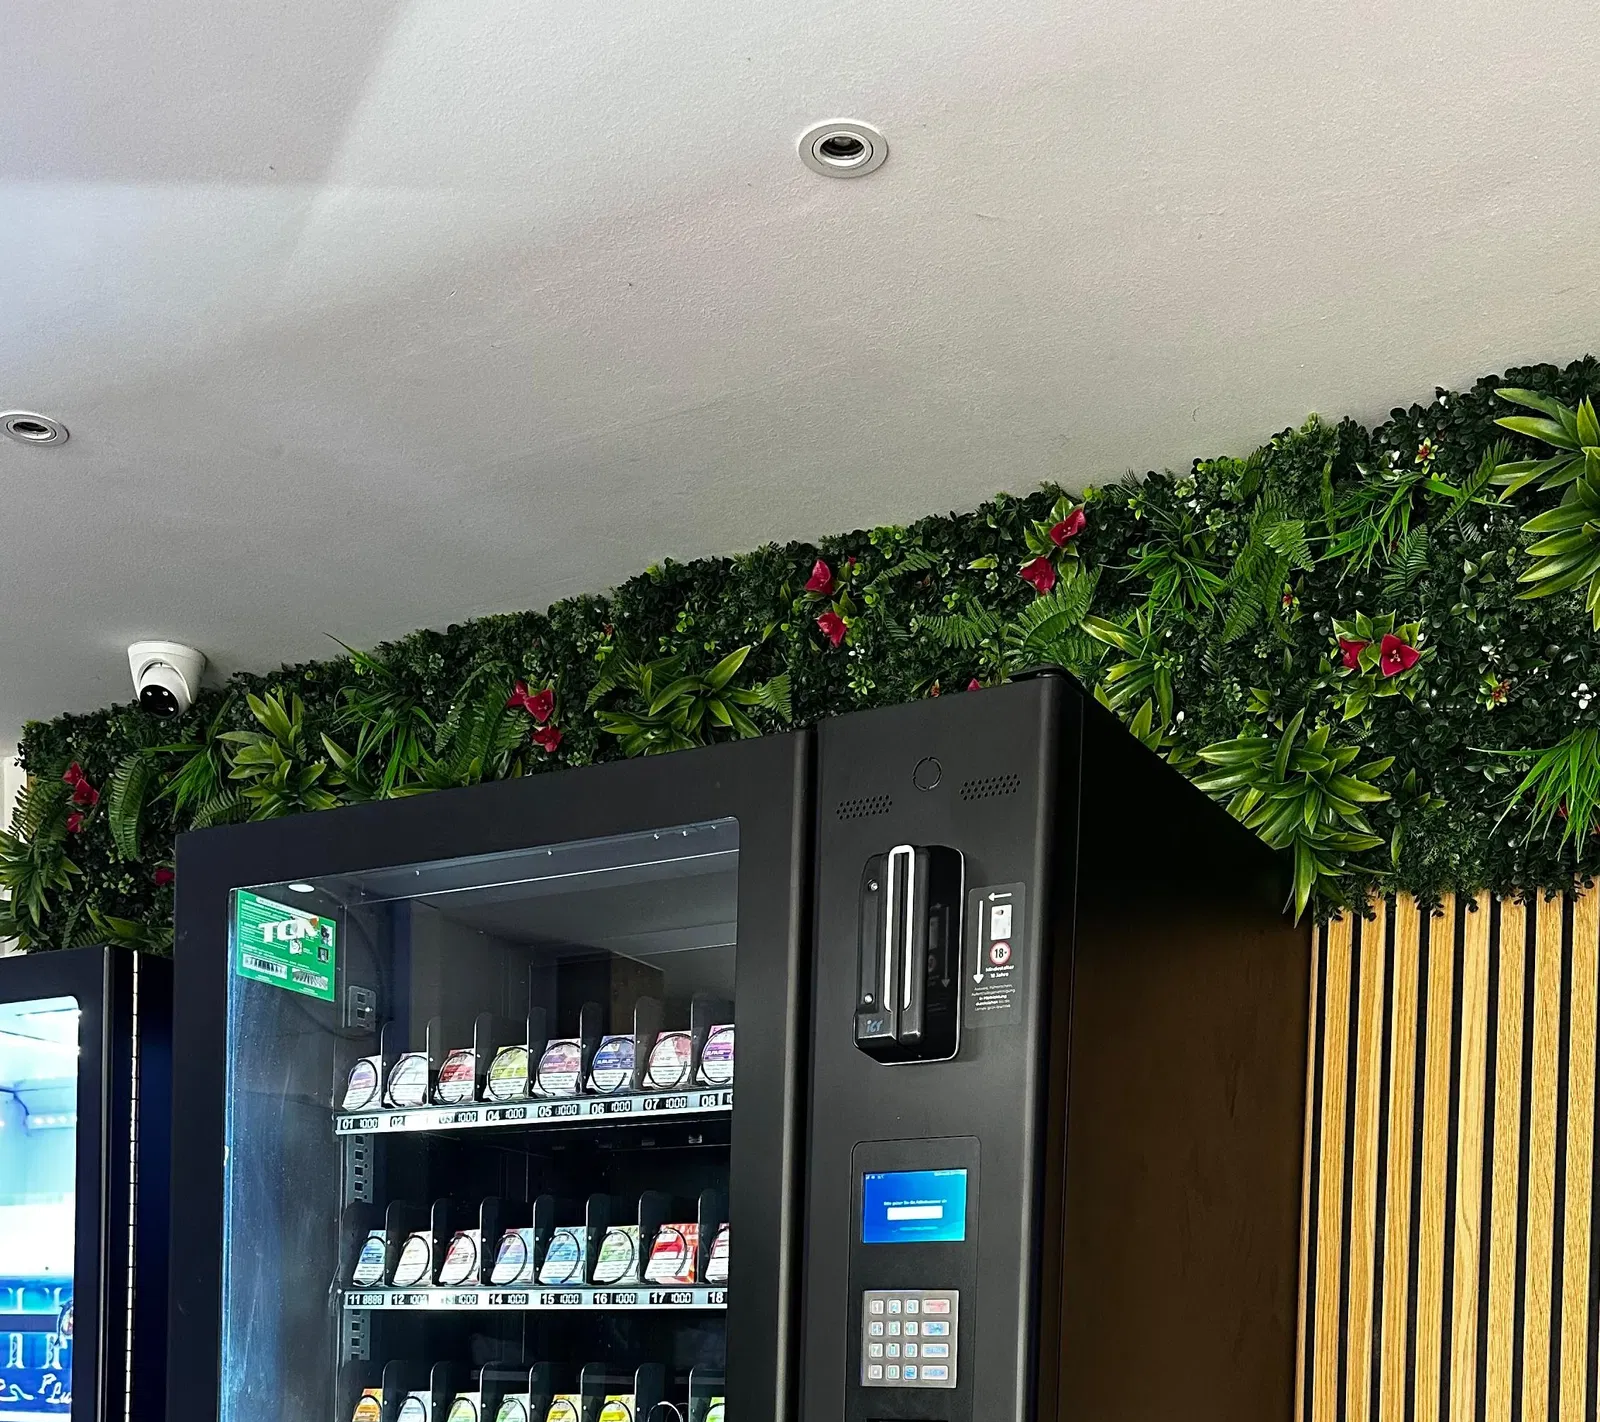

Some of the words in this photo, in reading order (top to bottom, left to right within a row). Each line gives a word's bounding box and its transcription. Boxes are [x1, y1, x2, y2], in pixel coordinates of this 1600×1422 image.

[645, 1099, 659, 1110] 07
[701, 1095, 715, 1106] 08
[539, 1107, 552, 1117] 05
[592, 1103, 604, 1114] 06
[487, 1110, 499, 1121] 04
[342, 1120, 353, 1129] 01
[391, 1117, 403, 1126] 02
[349, 1296, 360, 1304] 11
[393, 1295, 404, 1305] 12
[490, 1295, 502, 1304] 14
[542, 1294, 555, 1304] 15
[595, 1293, 607, 1304] 16
[651, 1292, 666, 1303] 17
[710, 1292, 724, 1303] 18
